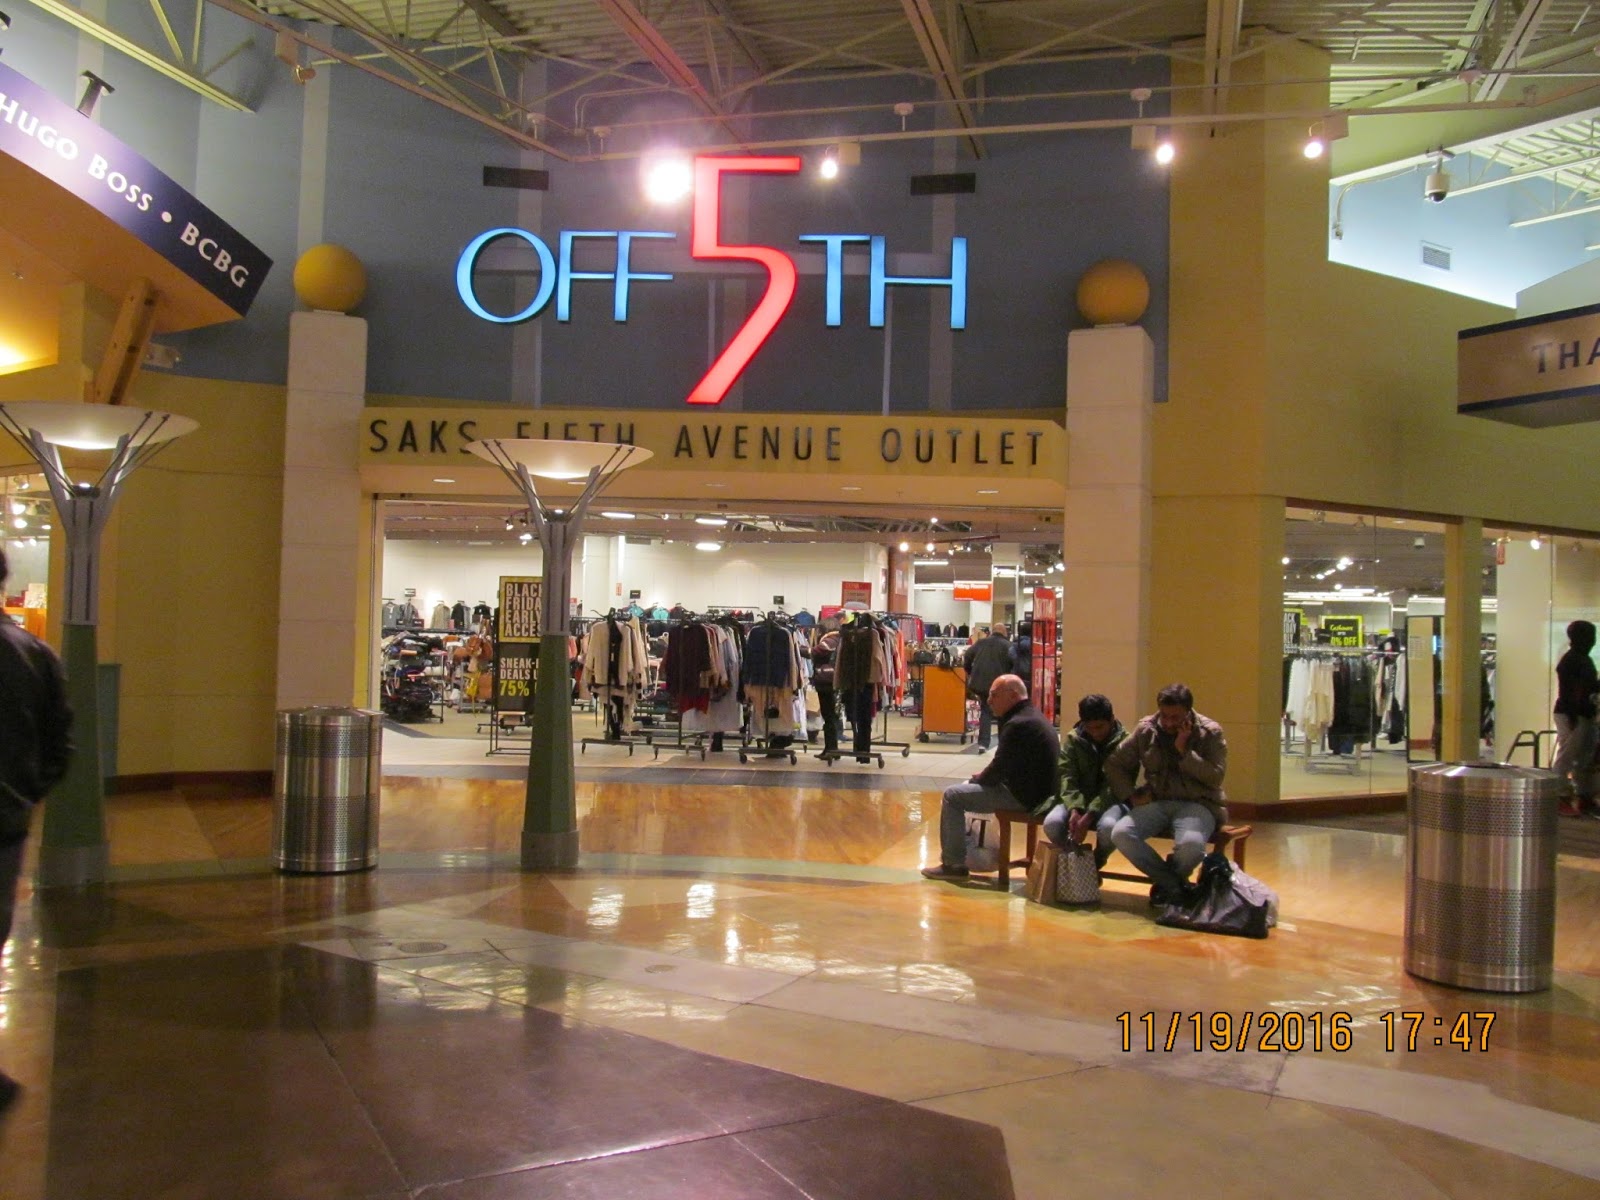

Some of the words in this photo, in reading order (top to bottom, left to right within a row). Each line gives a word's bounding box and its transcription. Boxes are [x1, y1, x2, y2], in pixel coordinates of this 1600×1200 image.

[0, 92, 79, 161] HUGO
[88, 153, 153, 211] BOSS
[180, 222, 249, 288] BCBG
[456, 227, 677, 322] OFF
[369, 419, 477, 454] SAKS
[673, 424, 842, 461] AVENUE
[880, 427, 1044, 466] OUTLET
[505, 596, 542, 610] FRIDA
[504, 623, 544, 637] ACCES
[1331, 637, 1343, 646] 0%
[1344, 636, 1358, 646] OFF
[500, 669, 530, 680] DEALS
[500, 680, 530, 697] 75%
